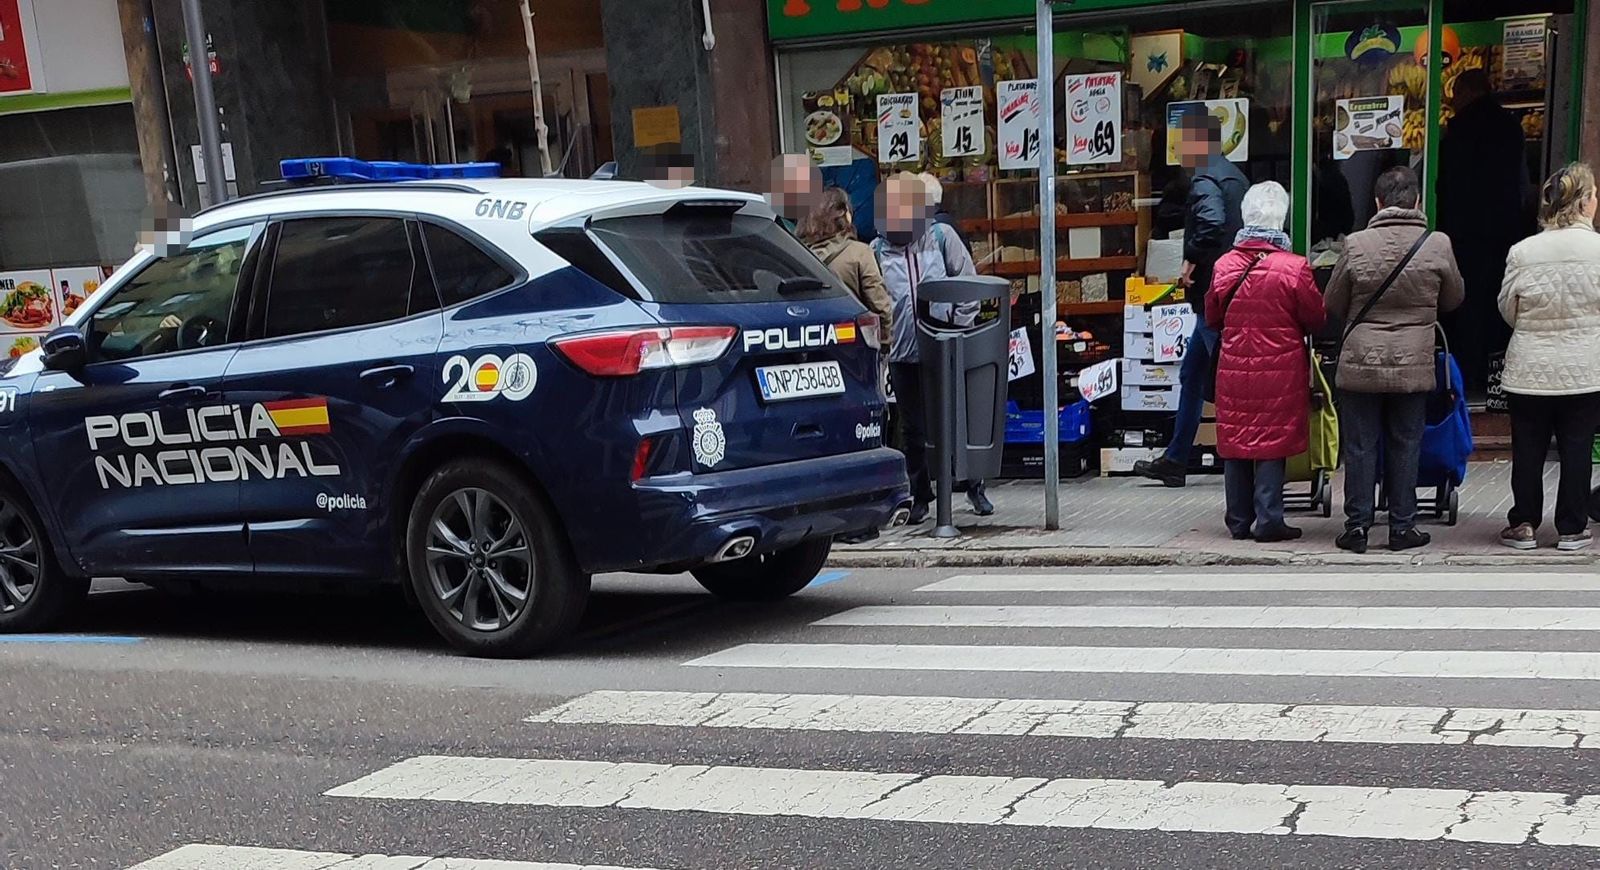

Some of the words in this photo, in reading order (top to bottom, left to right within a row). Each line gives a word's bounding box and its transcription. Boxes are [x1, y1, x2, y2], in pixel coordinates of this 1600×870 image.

[889, 131, 909, 160] 29
[952, 126, 973, 154] 15
[475, 198, 527, 220] 6NB
[440, 353, 537, 402] 200
[766, 366, 840, 394] CNP2584BB
[95, 441, 341, 489] NACIONAL
